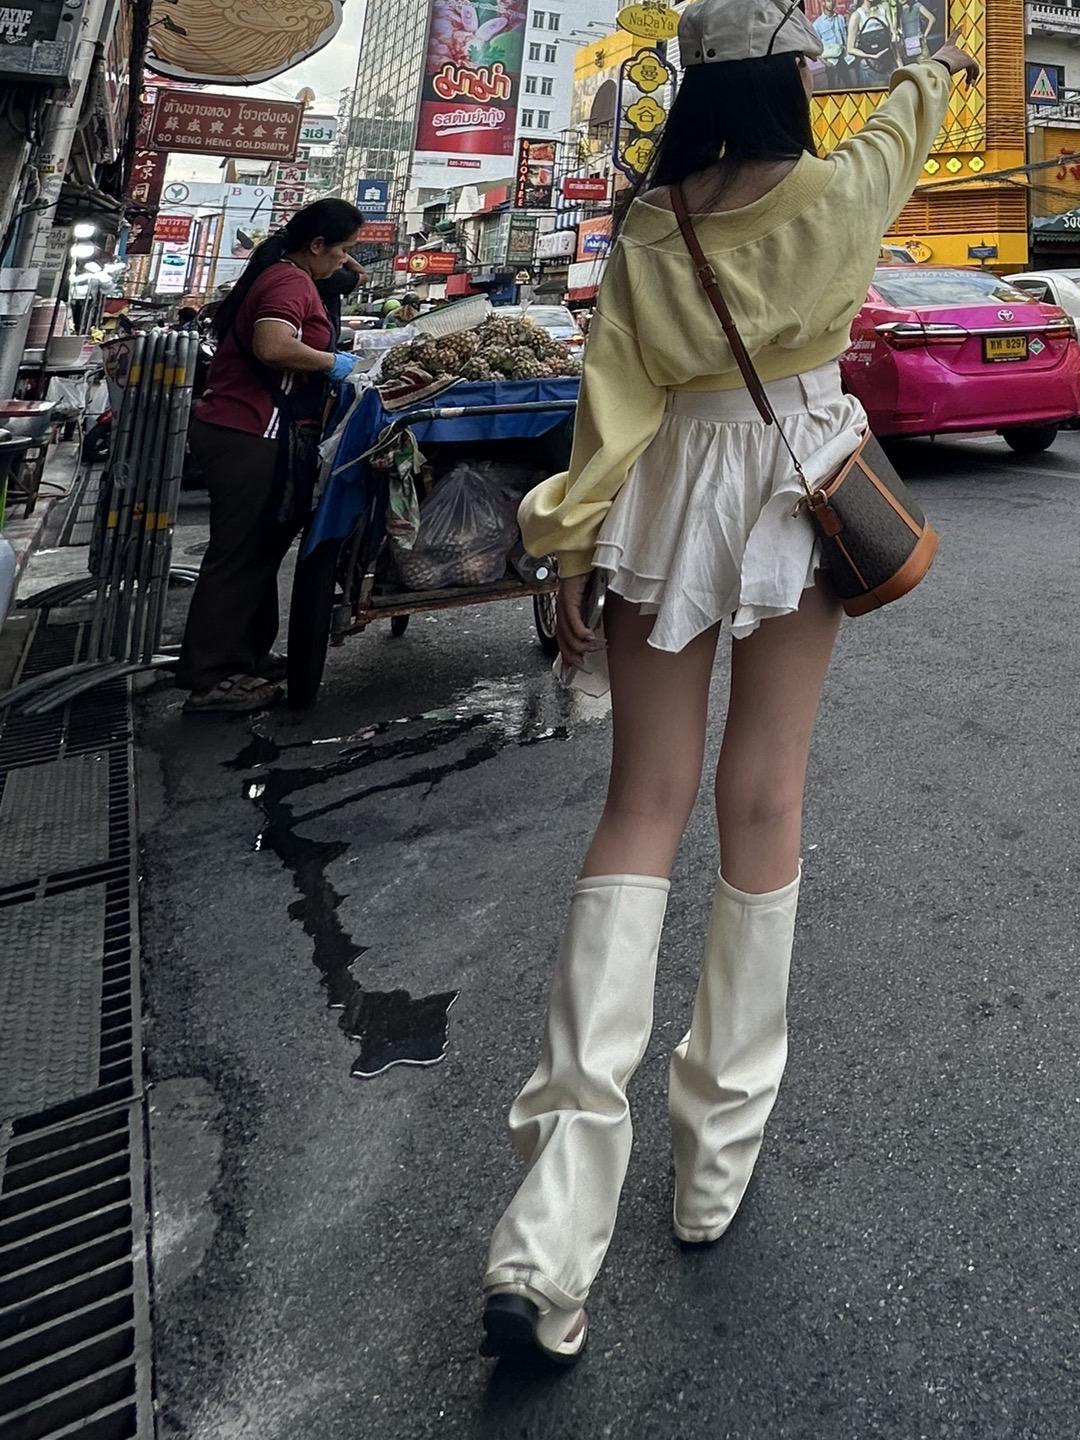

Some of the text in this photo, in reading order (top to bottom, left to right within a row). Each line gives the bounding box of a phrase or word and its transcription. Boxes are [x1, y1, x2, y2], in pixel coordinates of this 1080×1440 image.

[432, 107, 506, 127] รสต้มยำกุ้ง
[157, 132, 290, 152] SO SENG HENG GOLDSMITH
[1006, 337, 1026, 349] 8297
